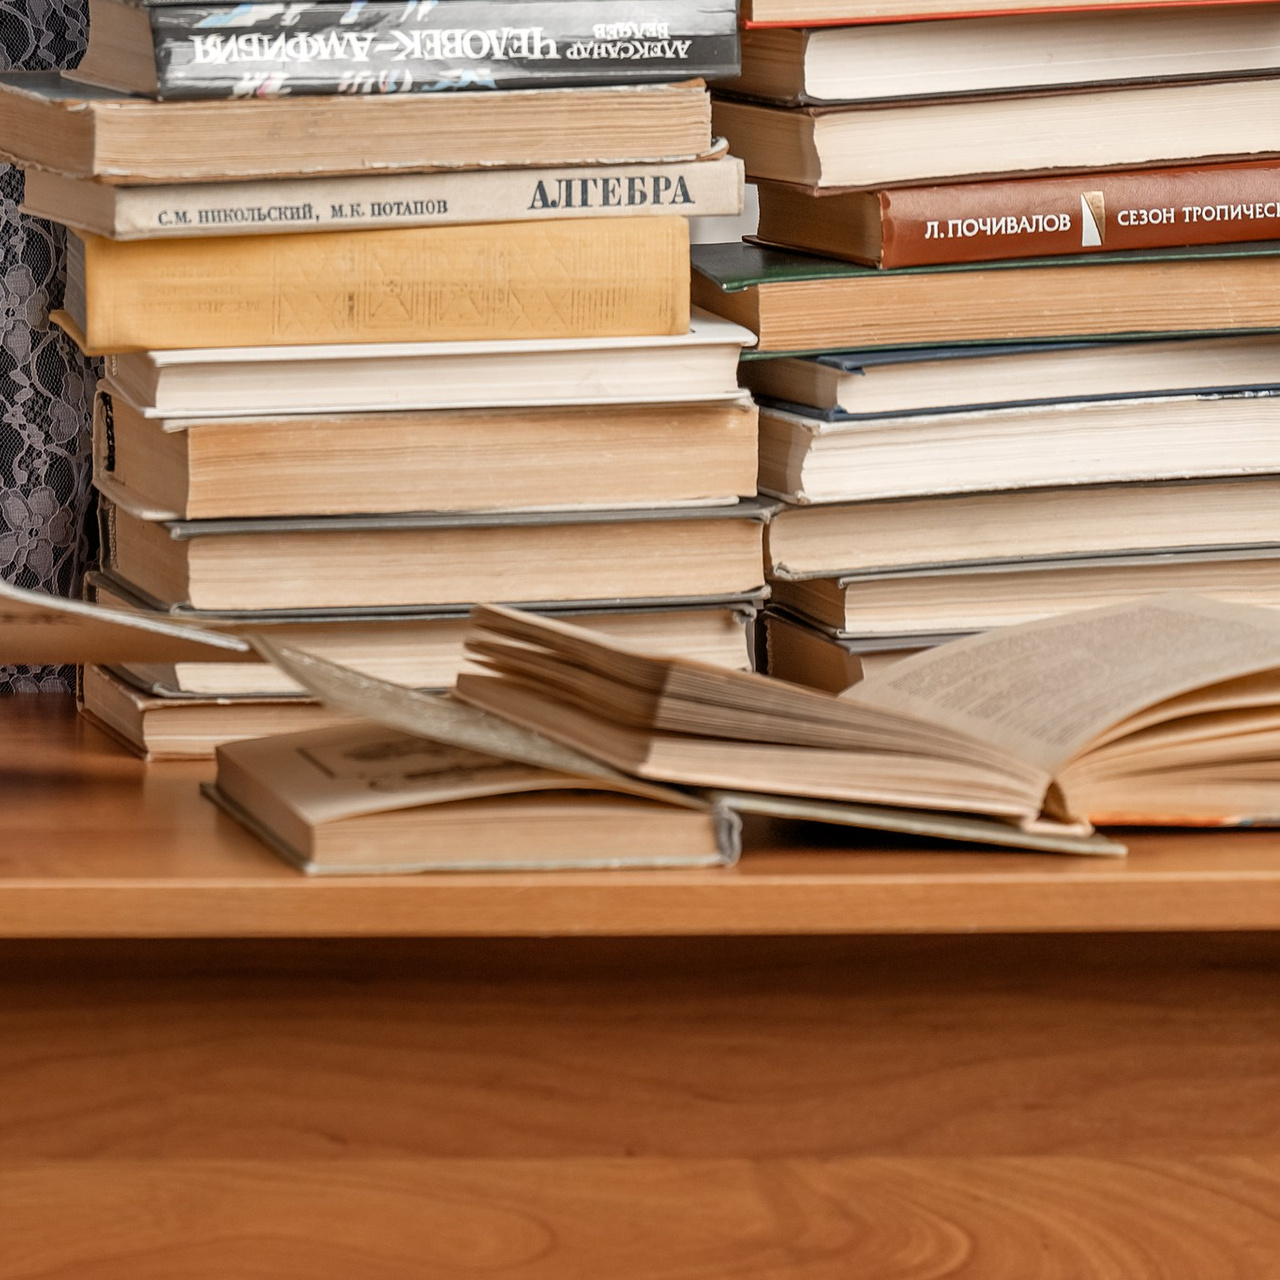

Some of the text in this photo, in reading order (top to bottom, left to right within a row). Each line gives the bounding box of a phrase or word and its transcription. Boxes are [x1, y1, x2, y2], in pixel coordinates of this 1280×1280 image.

[592, 21, 670, 39] БЕЛЯЕВ
[566, 38, 692, 60] АЛЕКСАНДР
[527, 175, 696, 211] АЛГЕБРА
[370, 198, 449, 217] ПОТАПОВ
[1117, 208, 1176, 227] СЕЗОН
